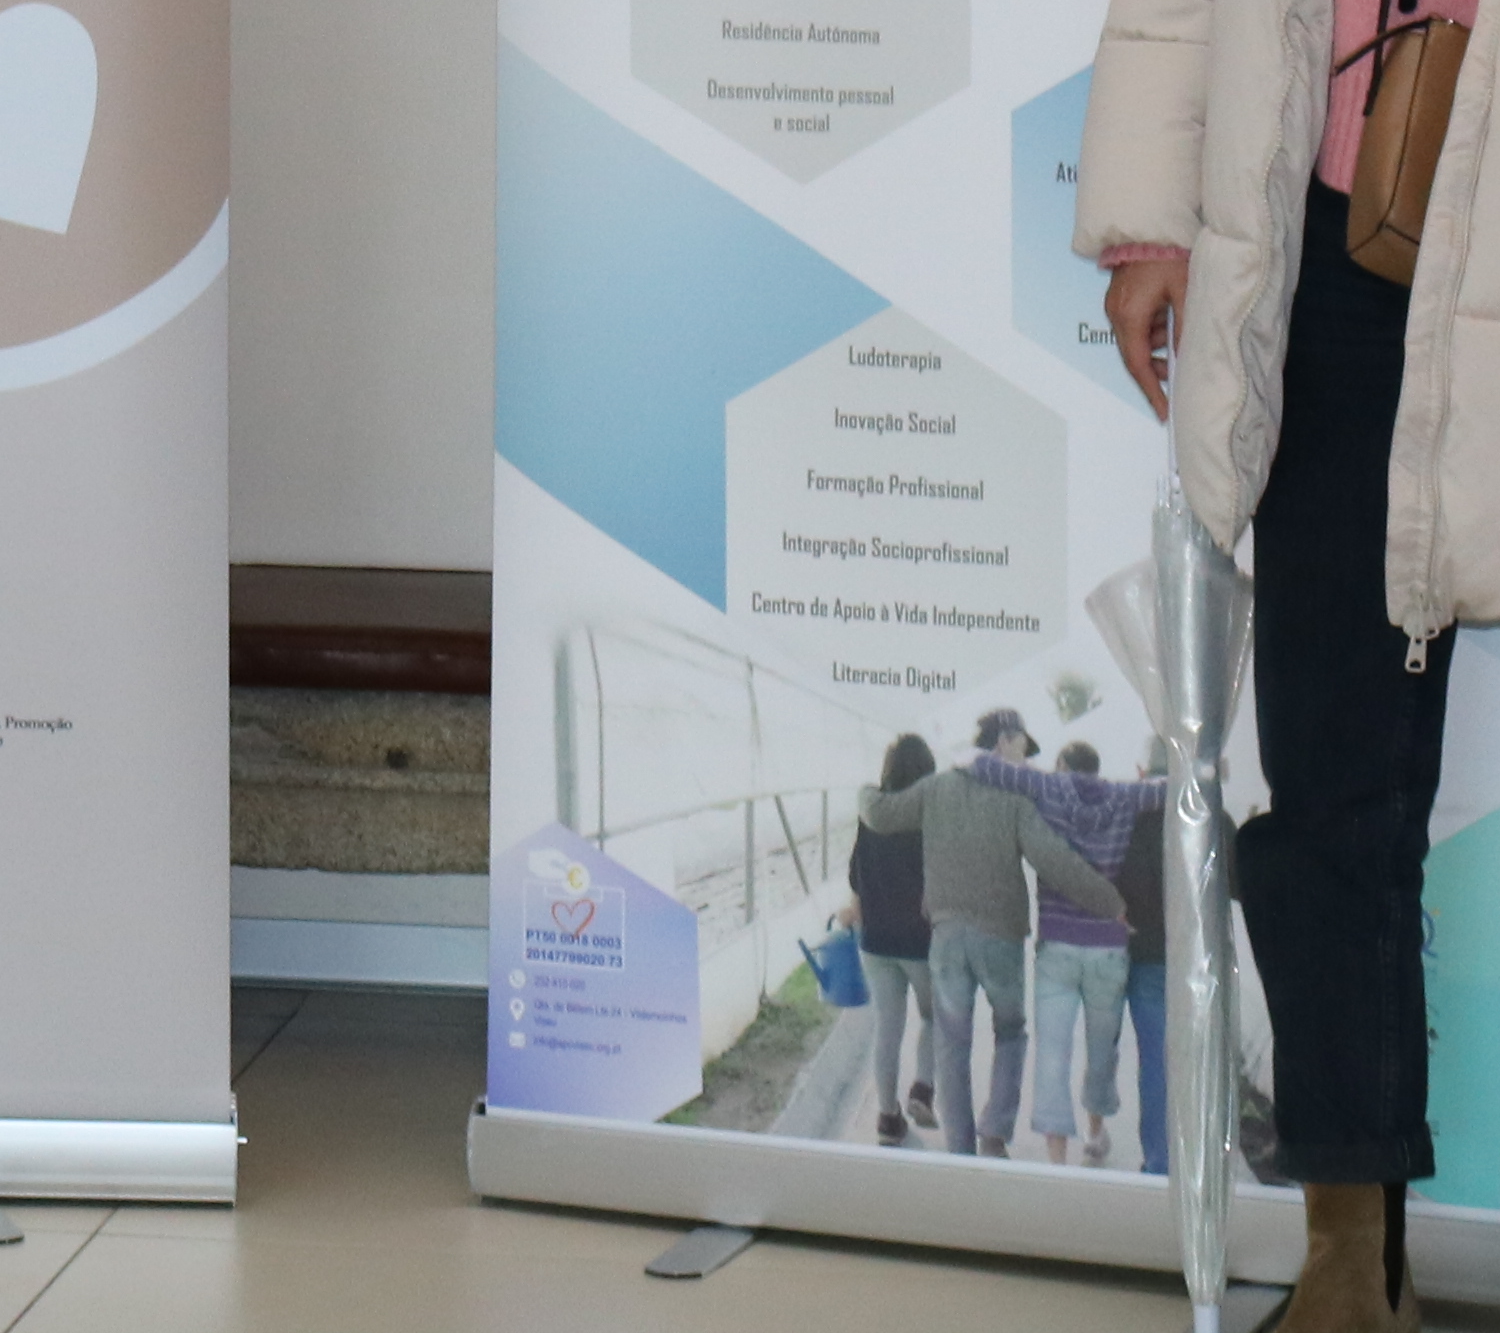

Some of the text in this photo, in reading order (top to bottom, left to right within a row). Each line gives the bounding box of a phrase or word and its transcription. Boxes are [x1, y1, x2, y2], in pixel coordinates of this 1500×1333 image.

[722, 20, 880, 45] Residência Autónoma
[707, 79, 894, 107] Desenvolvimento pessoal
[774, 114, 830, 133] e social
[849, 345, 941, 373] Ludoterapia
[835, 407, 956, 435] Inovação Social
[807, 469, 984, 500] Formação Profissional
[783, 531, 1009, 566] Integração Socioprofissional
[752, 592, 1040, 632] Centro de Apoio à Vida Independente
[832, 661, 956, 693] Literacia Digital
[5, 716, 73, 733] Promoção
